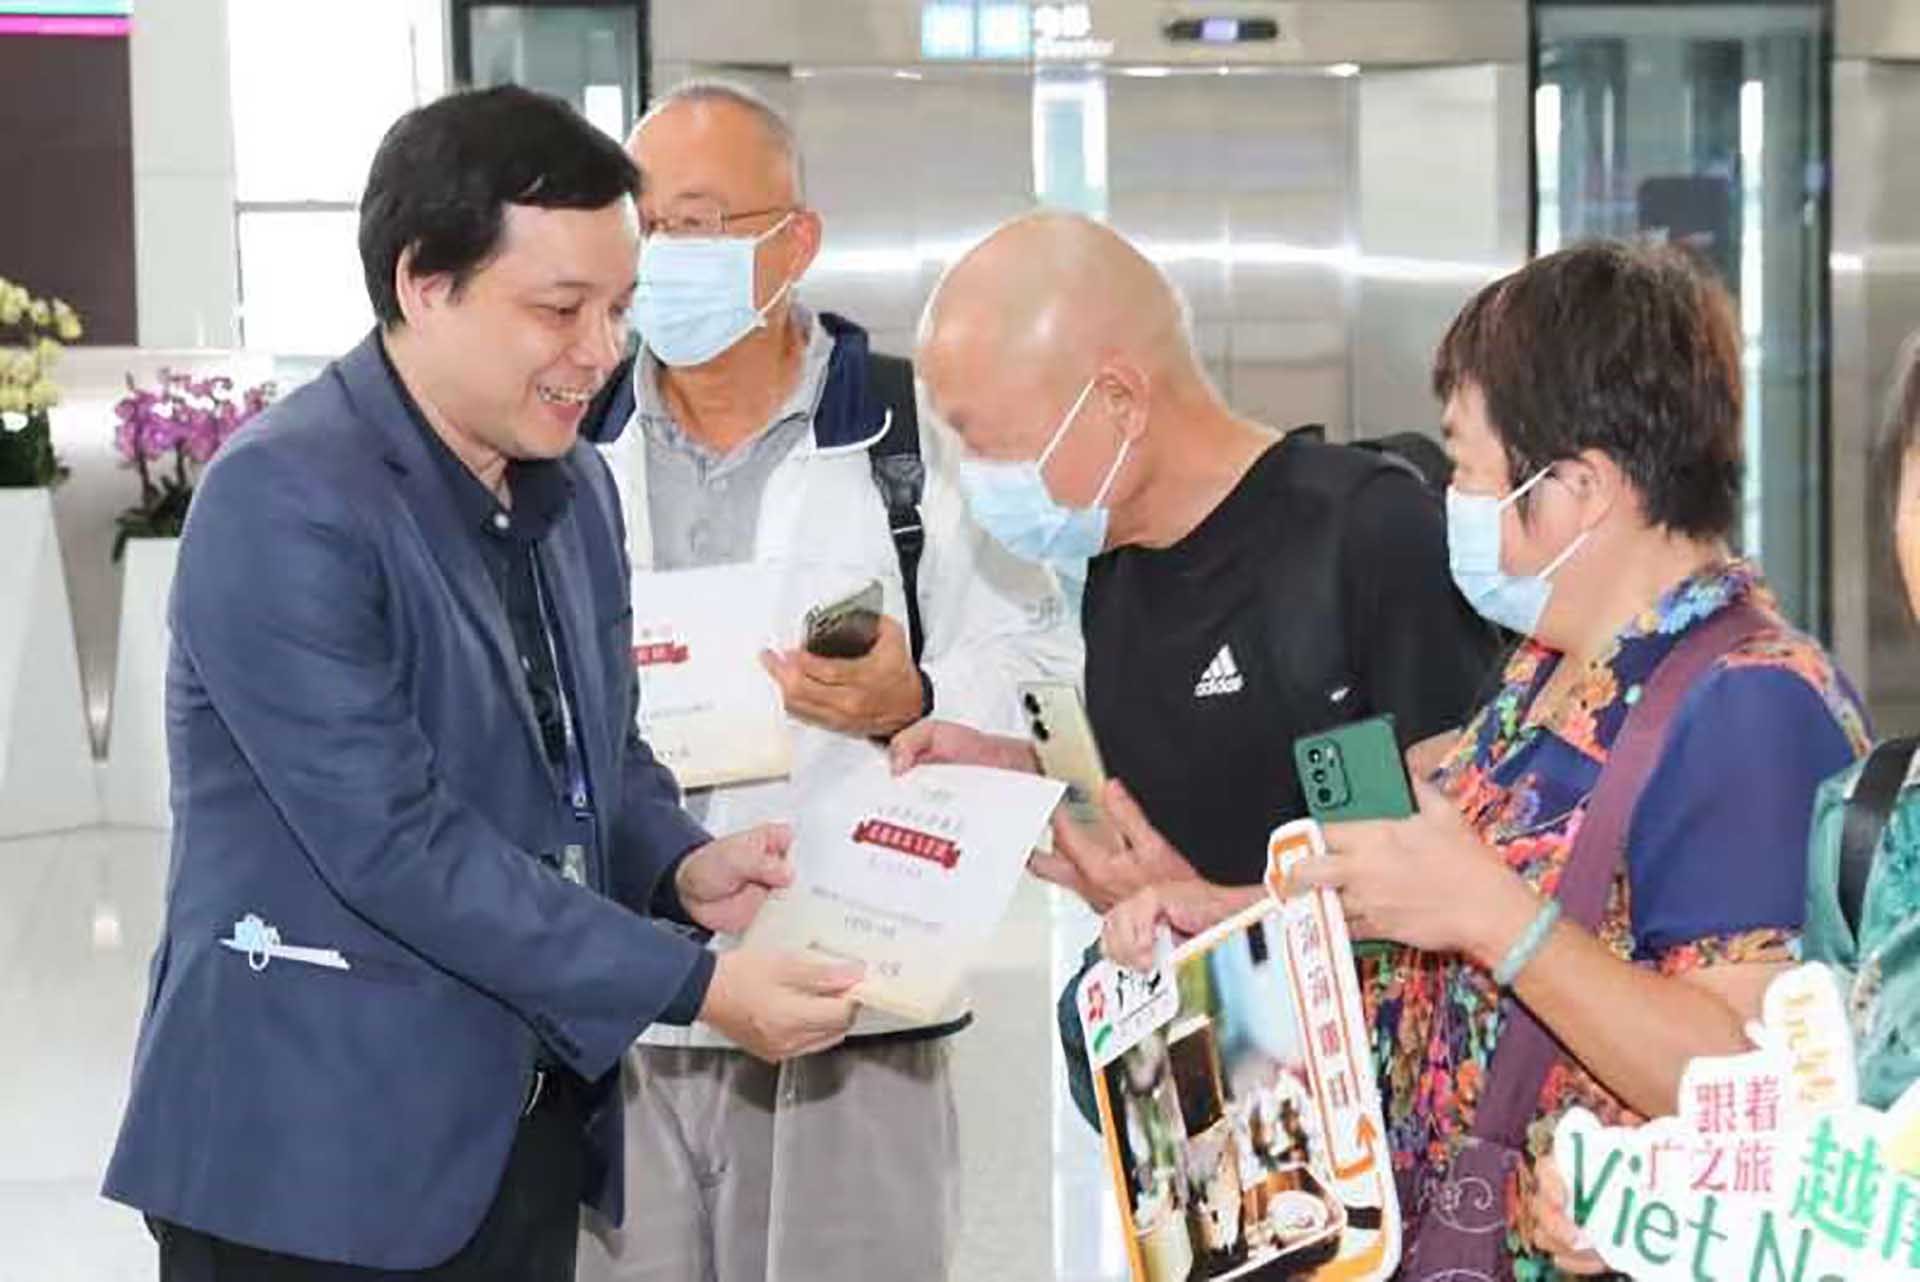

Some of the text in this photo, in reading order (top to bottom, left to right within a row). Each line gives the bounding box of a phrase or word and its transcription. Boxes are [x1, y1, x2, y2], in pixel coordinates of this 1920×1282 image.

[1193, 674, 1243, 697] adidas
[1646, 1139, 1774, 1193] 广之旅
[1570, 1132, 1844, 1282] Viet N
